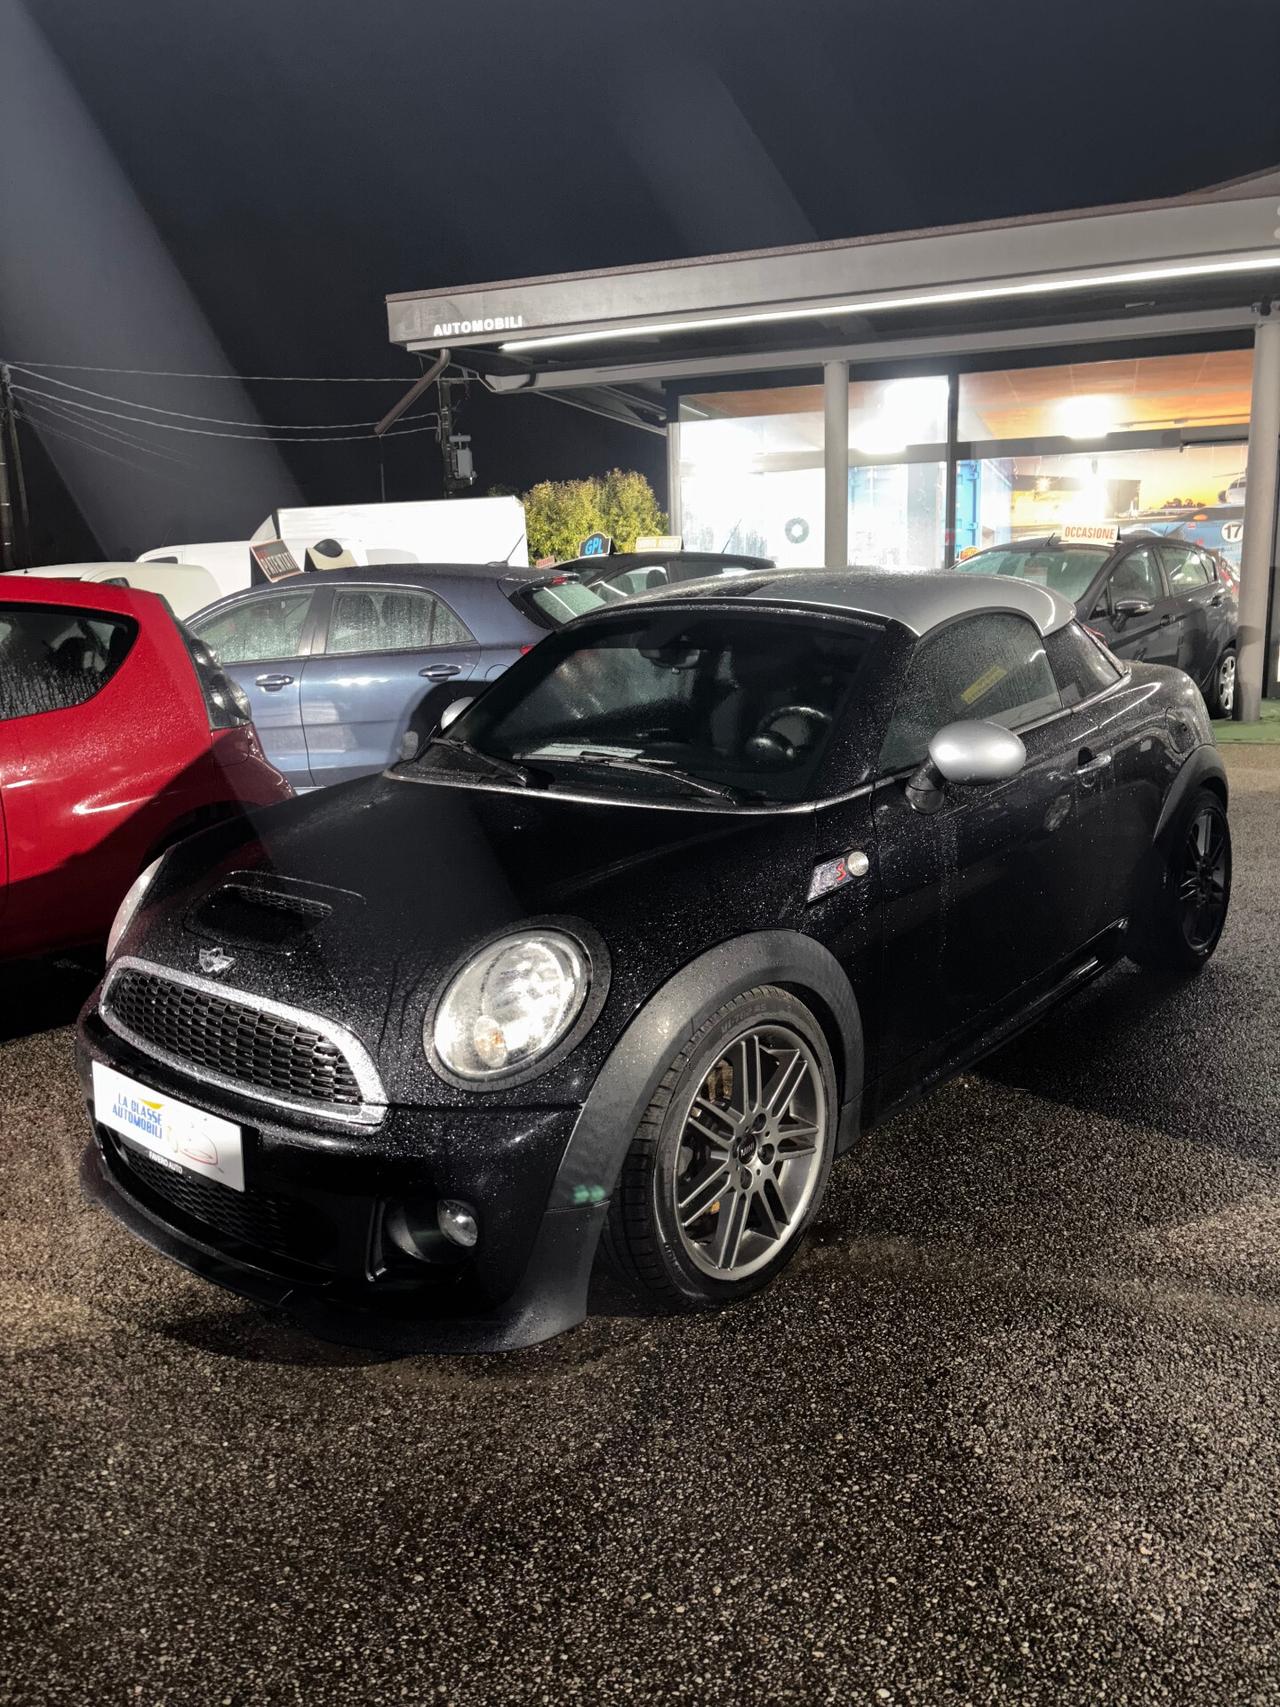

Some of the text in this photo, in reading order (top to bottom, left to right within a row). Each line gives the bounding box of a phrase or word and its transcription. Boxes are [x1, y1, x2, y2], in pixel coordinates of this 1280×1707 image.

[433, 315, 523, 336] AUTOMOBILI
[1064, 526, 1116, 539] OCCASIONE
[1224, 524, 1242, 539] 17
[584, 537, 603, 555] GPL
[118, 1092, 128, 1108] LA
[112, 1103, 163, 1139] AUTOMOBILI
